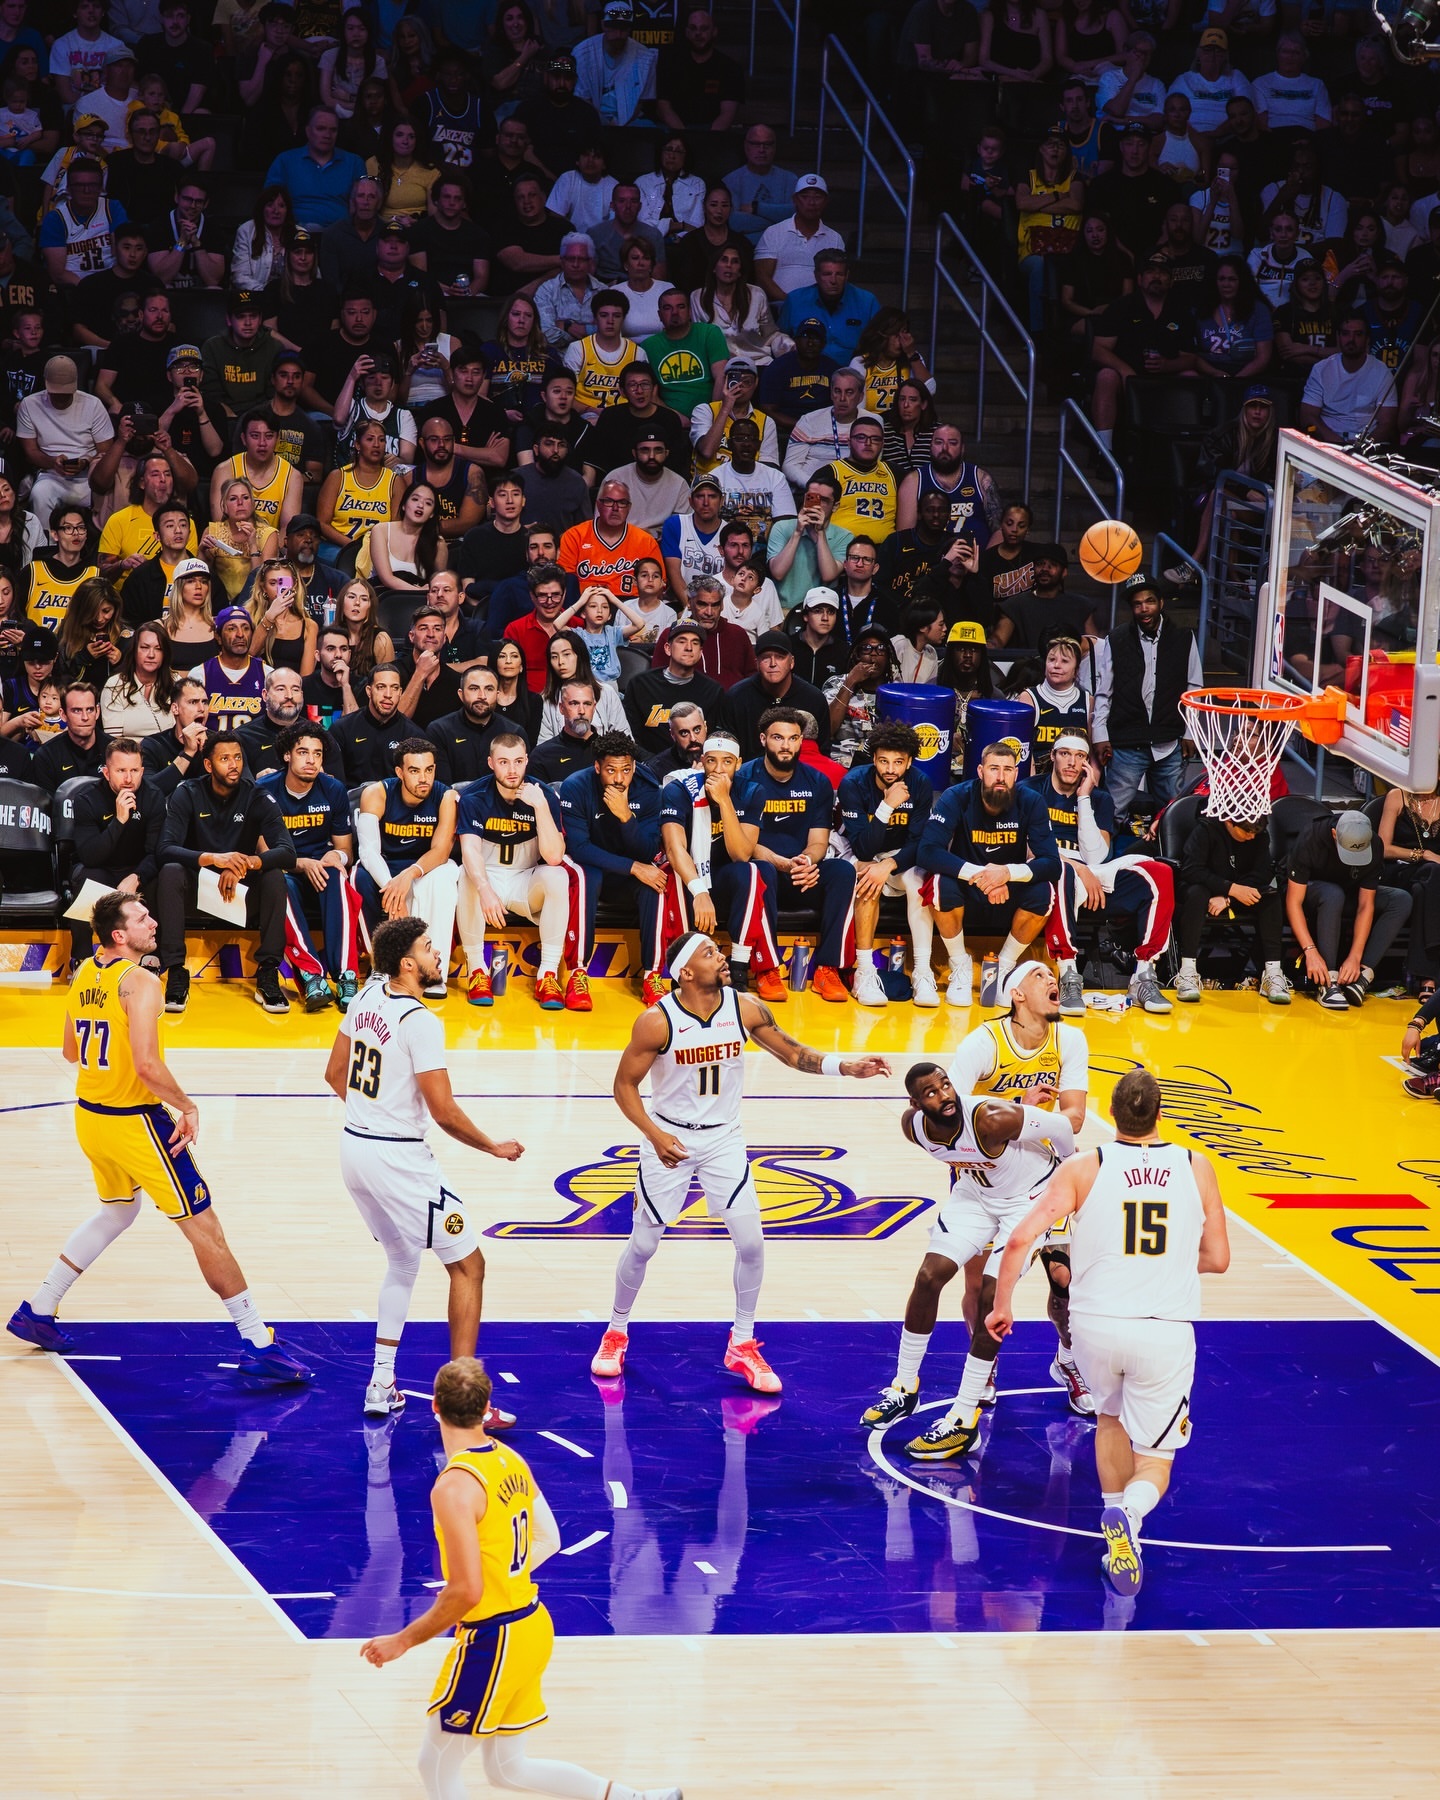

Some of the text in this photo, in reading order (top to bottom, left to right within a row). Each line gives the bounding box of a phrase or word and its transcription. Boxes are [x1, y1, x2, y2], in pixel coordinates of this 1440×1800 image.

[432, 124, 474, 145] LAKERS
[844, 479, 890, 497] LAKERS
[338, 494, 389, 515] LAKERS
[856, 498, 885, 519] 23
[682, 544, 725, 575] 5280
[621, 575, 635, 594] 8
[993, 561, 1035, 600] NIKE
[208, 692, 264, 715] LAKERS
[790, 789, 813, 798] ibotta
[308, 804, 332, 817] ibotta
[413, 814, 438, 824] ibotta
[512, 811, 536, 823] ibotta
[384, 822, 434, 838] NUGGETS
[485, 817, 531, 833] NUGGETS
[996, 819, 1020, 830] ibotta
[970, 829, 1018, 845] NUGGETS
[354, 1010, 392, 1047] JOHNSON
[716, 1020, 736, 1029] ibotta
[75, 1018, 112, 1071] 77
[674, 1040, 742, 1066] NUGGETS
[347, 1039, 384, 1100] 23
[698, 1063, 721, 1098] 11
[987, 1070, 1057, 1093] LAKERS
[1123, 1166, 1171, 1189] JOKIĆ
[1121, 1200, 1168, 1257] 15
[496, 1472, 530, 1509] KENNARD
[507, 1507, 530, 1578] 10
